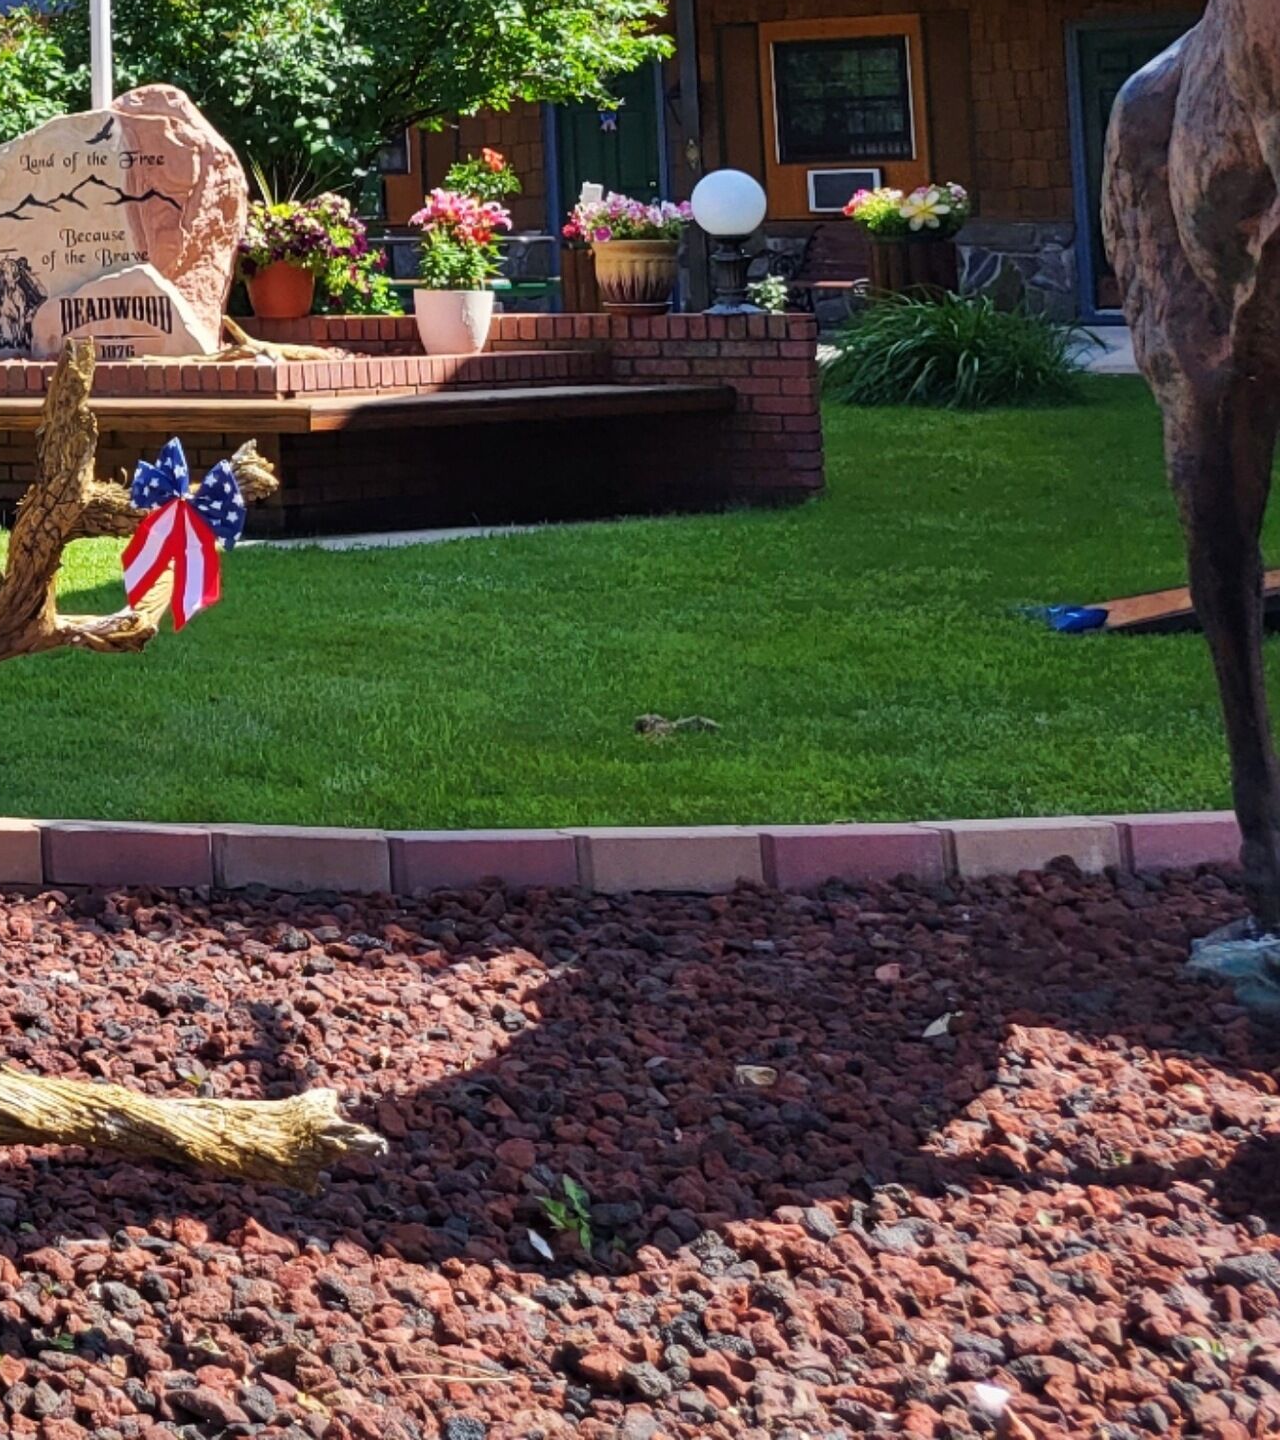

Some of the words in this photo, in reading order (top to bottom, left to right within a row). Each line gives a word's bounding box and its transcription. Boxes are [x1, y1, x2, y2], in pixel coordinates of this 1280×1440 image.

[19, 152, 55, 175] Land
[62, 151, 79, 173] of
[87, 151, 108, 166] the
[119, 150, 166, 169] Free
[59, 228, 125, 248] Because
[42, 250, 56, 271] of
[64, 248, 86, 264] the
[94, 248, 149, 268] Brave
[59, 295, 172, 337] DEADWOOD
[100, 344, 136, 359] 1876
